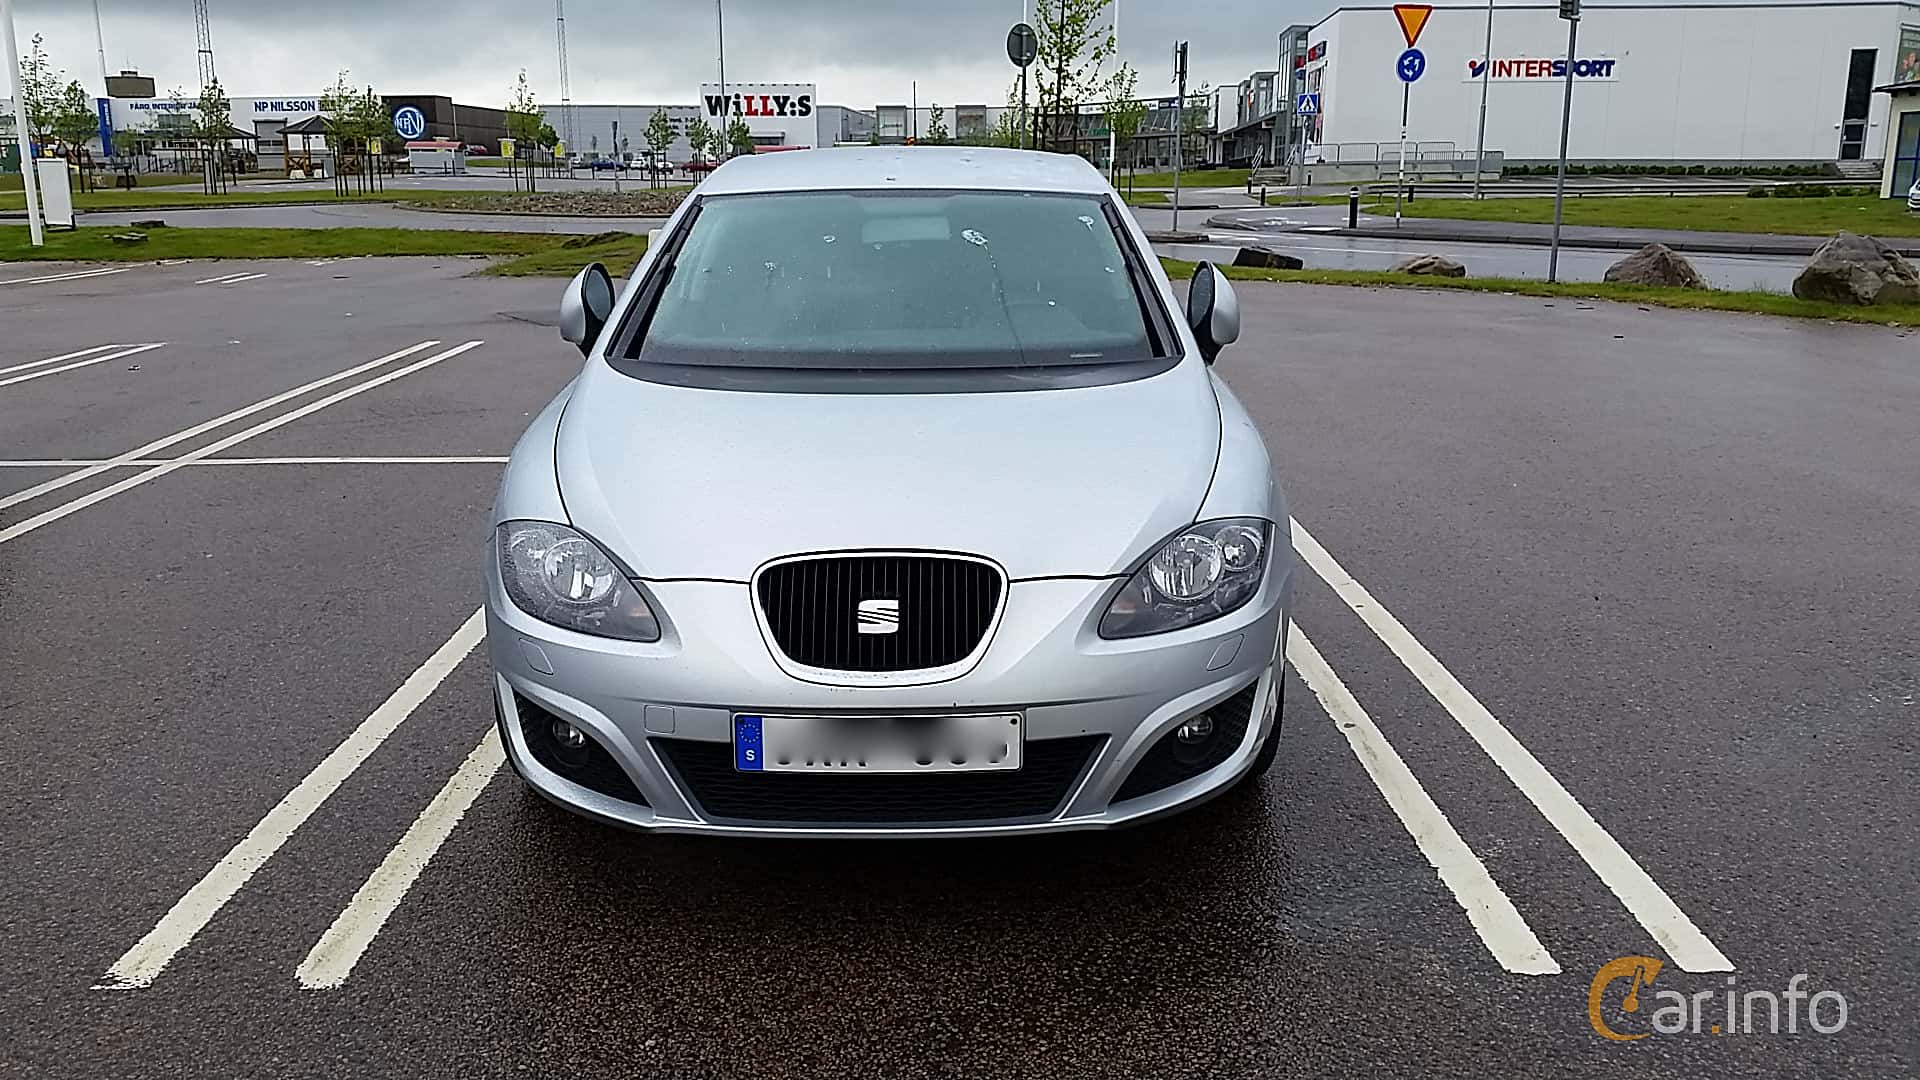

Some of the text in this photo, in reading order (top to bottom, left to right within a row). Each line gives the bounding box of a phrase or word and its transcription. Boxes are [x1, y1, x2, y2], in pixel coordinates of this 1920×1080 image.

[1492, 60, 1616, 78] INTERSPORT
[254, 101, 269, 112] NP
[270, 101, 316, 112] NILSSON
[746, 750, 755, 761] S
